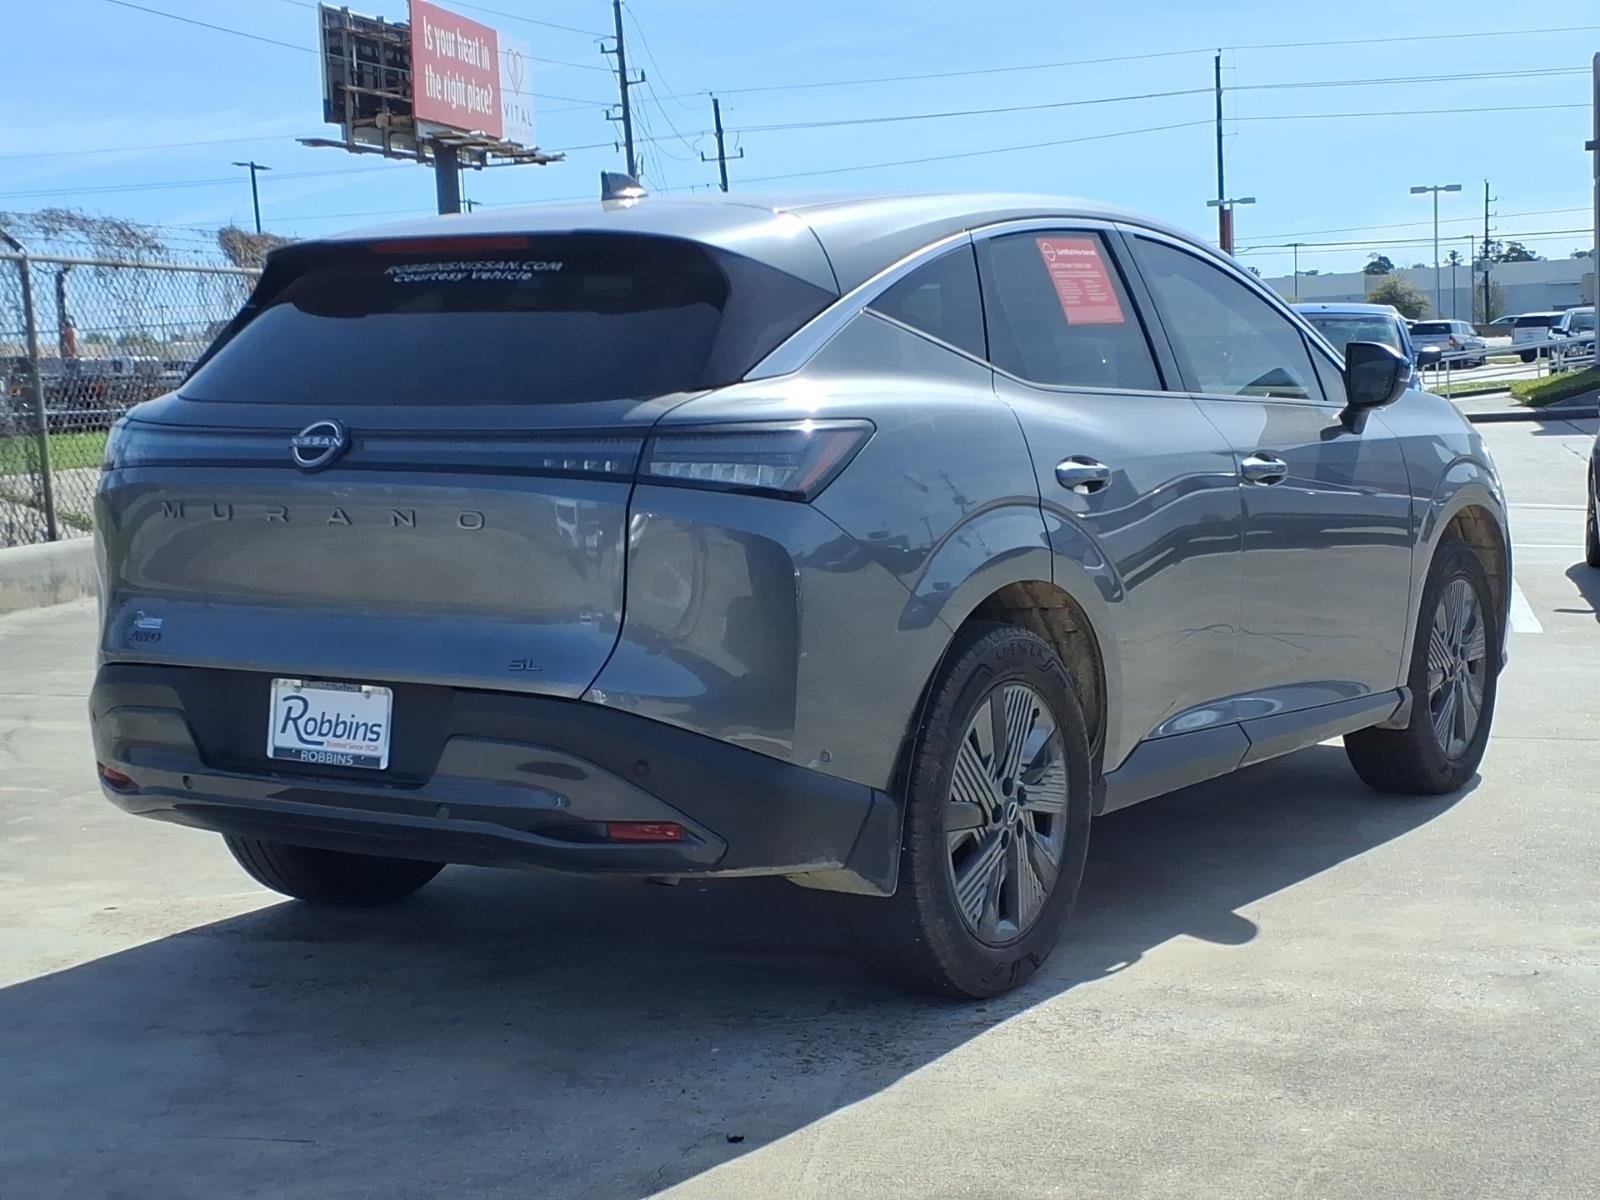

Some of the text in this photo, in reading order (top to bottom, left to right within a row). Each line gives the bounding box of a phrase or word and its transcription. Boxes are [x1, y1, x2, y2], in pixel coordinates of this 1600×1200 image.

[423, 15, 491, 71] Is your heart in
[425, 63, 493, 115] the right place?
[503, 101, 532, 127] VITAL
[471, 270, 533, 281] Vehicle
[292, 436, 343, 446] NISSAN
[160, 500, 486, 531] MURANO
[509, 659, 543, 671] SL
[280, 695, 382, 746] Robbins
[300, 750, 353, 765] ROBBINS
